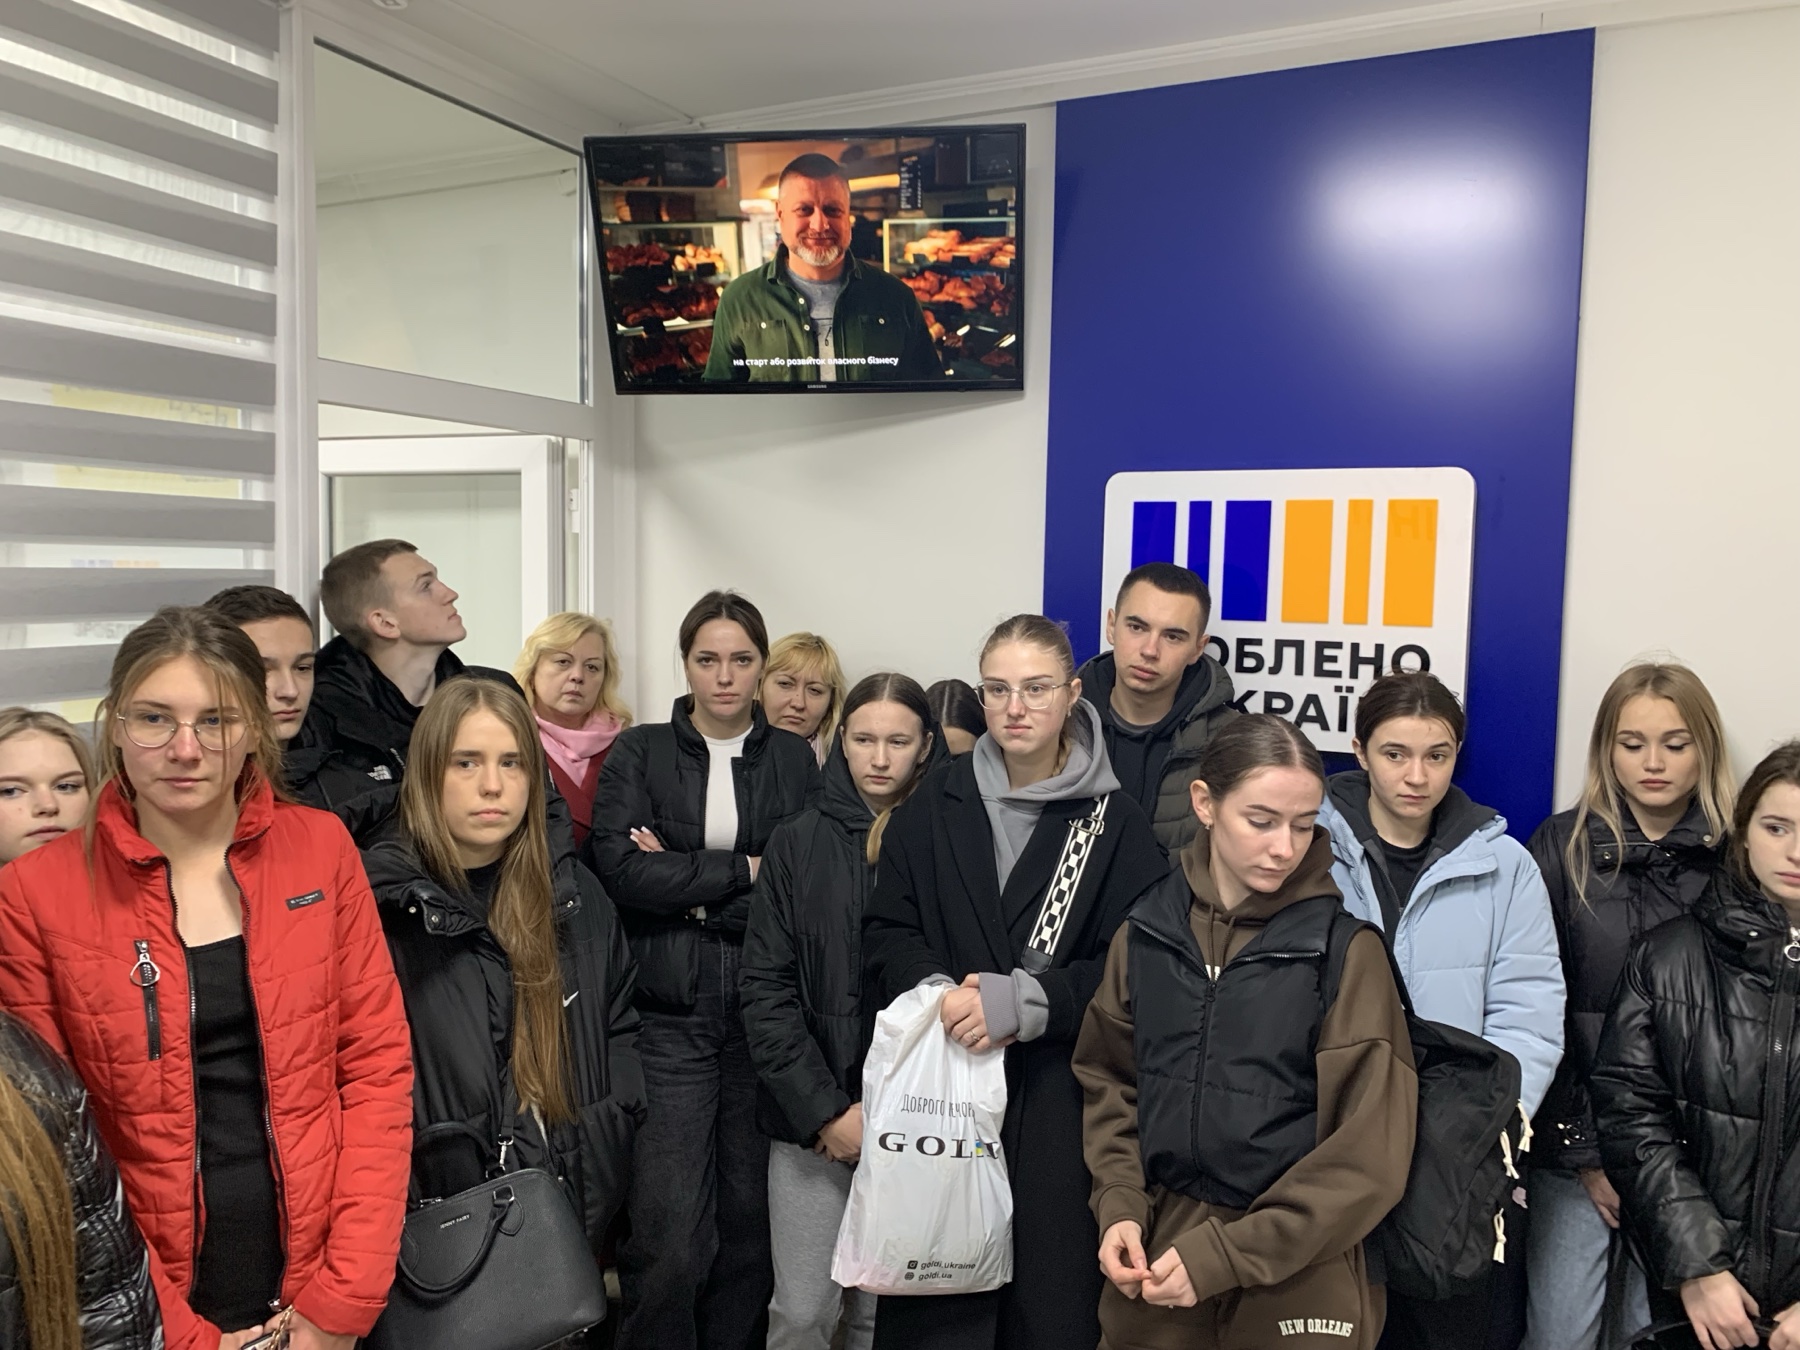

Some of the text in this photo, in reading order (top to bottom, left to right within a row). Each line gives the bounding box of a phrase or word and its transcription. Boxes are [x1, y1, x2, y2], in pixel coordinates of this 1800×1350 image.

[745, 359, 768, 367] старт
[769, 357, 785, 366] або
[827, 358, 866, 366] власного
[867, 356, 899, 366] бізнесу
[1208, 635, 1431, 680] ОБЛЕНО
[1277, 1318, 1354, 1338] NEW ORLEANS
